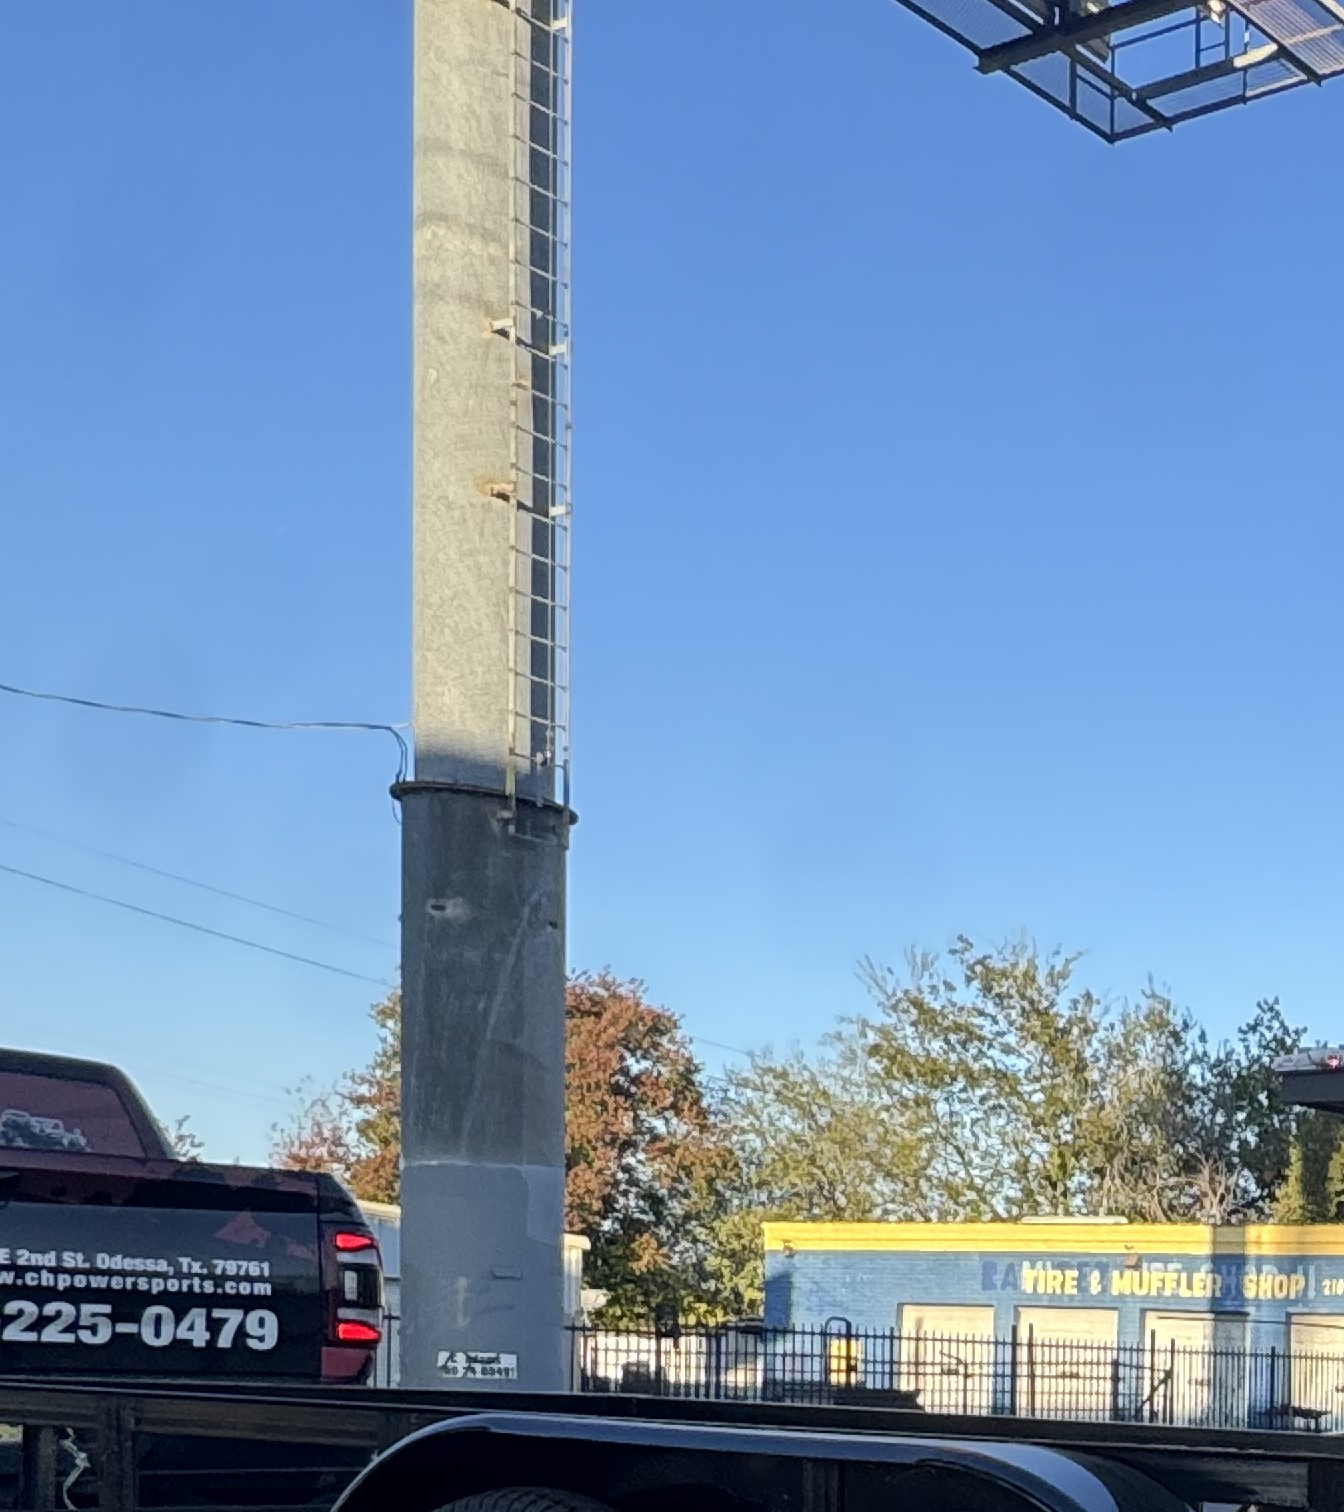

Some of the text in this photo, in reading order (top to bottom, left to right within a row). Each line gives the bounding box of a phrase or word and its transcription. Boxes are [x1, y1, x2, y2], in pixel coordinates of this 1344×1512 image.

[16, 1249, 57, 1267] 2nd
[61, 1250, 90, 1270] St.
[96, 1252, 174, 1275] Odessa,
[177, 1256, 208, 1274] Tx.
[211, 1259, 271, 1277] 79761
[1021, 1268, 1080, 1295] TIRE
[1111, 1270, 1222, 1298] MUFFLER
[1243, 1272, 1306, 1300] SHOP
[2, 1300, 280, 1351] 225-0479
